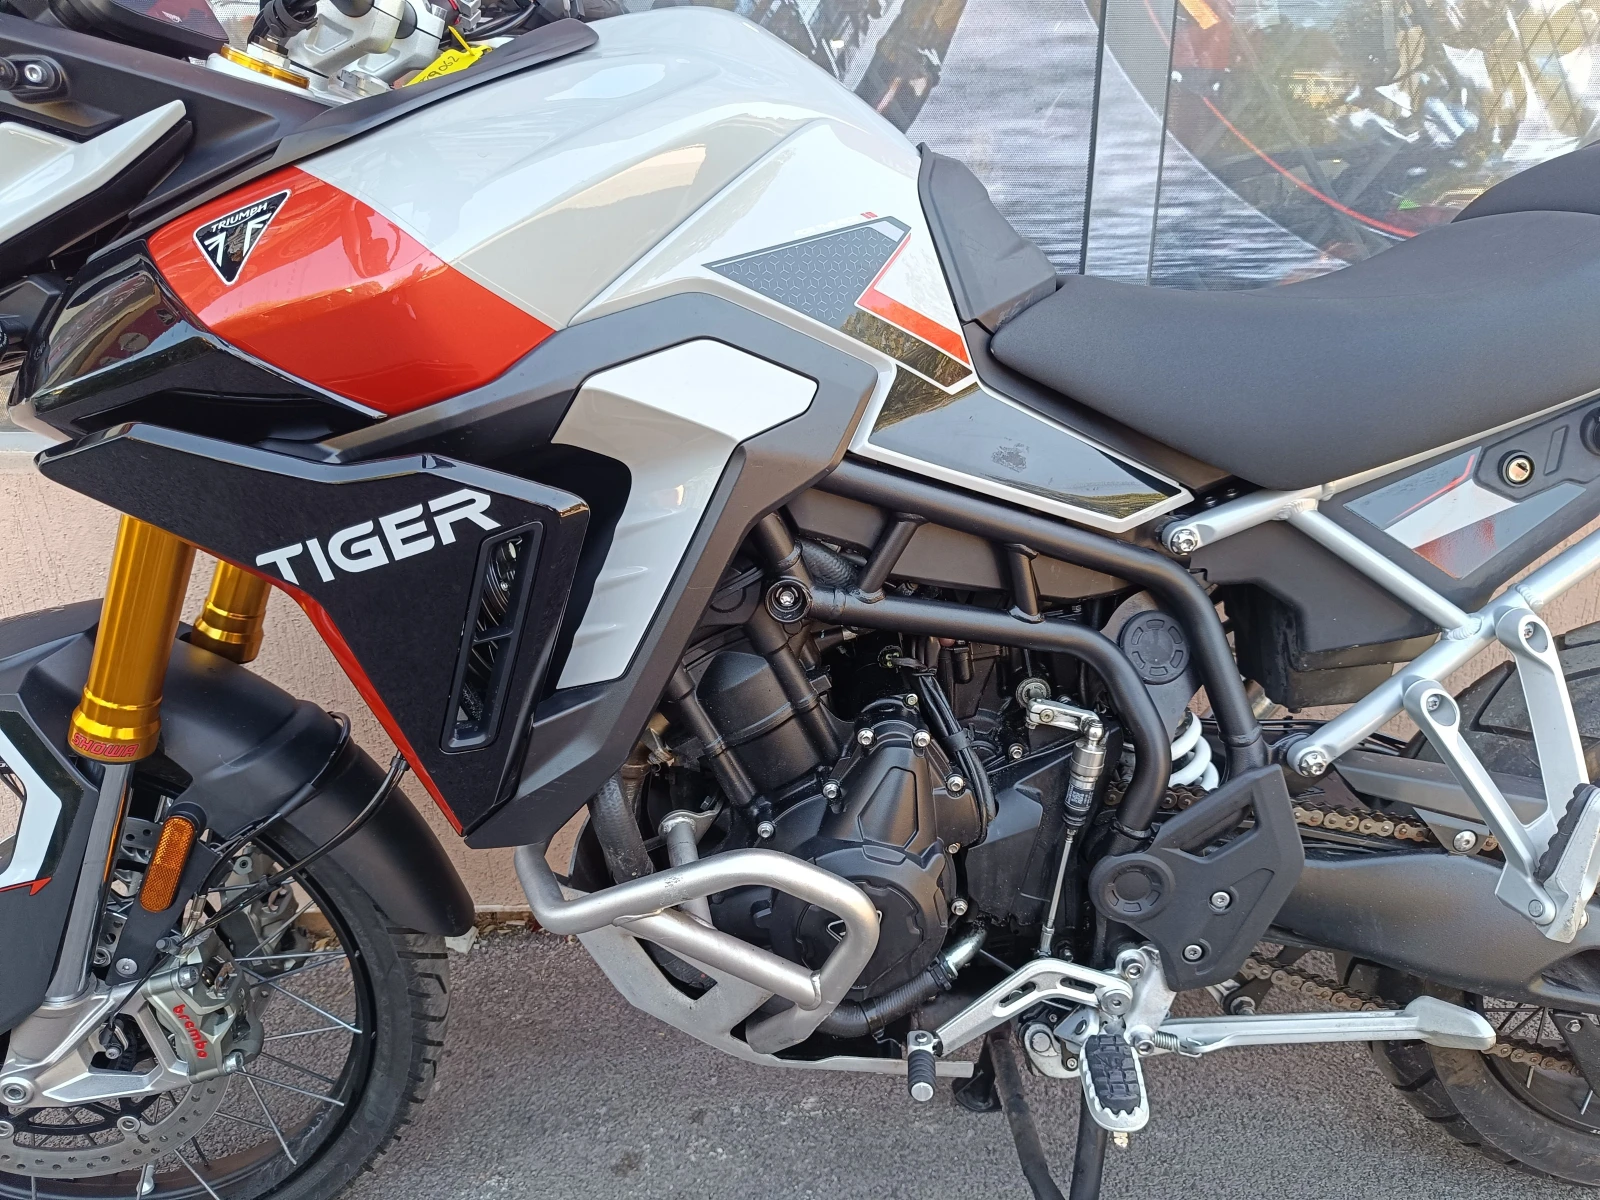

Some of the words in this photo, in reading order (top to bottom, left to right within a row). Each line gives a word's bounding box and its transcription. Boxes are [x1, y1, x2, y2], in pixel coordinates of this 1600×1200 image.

[211, 202, 268, 232] TRIUMPH
[256, 488, 502, 586] TIGER
[72, 732, 140, 758] SHOWA
[173, 1003, 208, 1059] brembo
